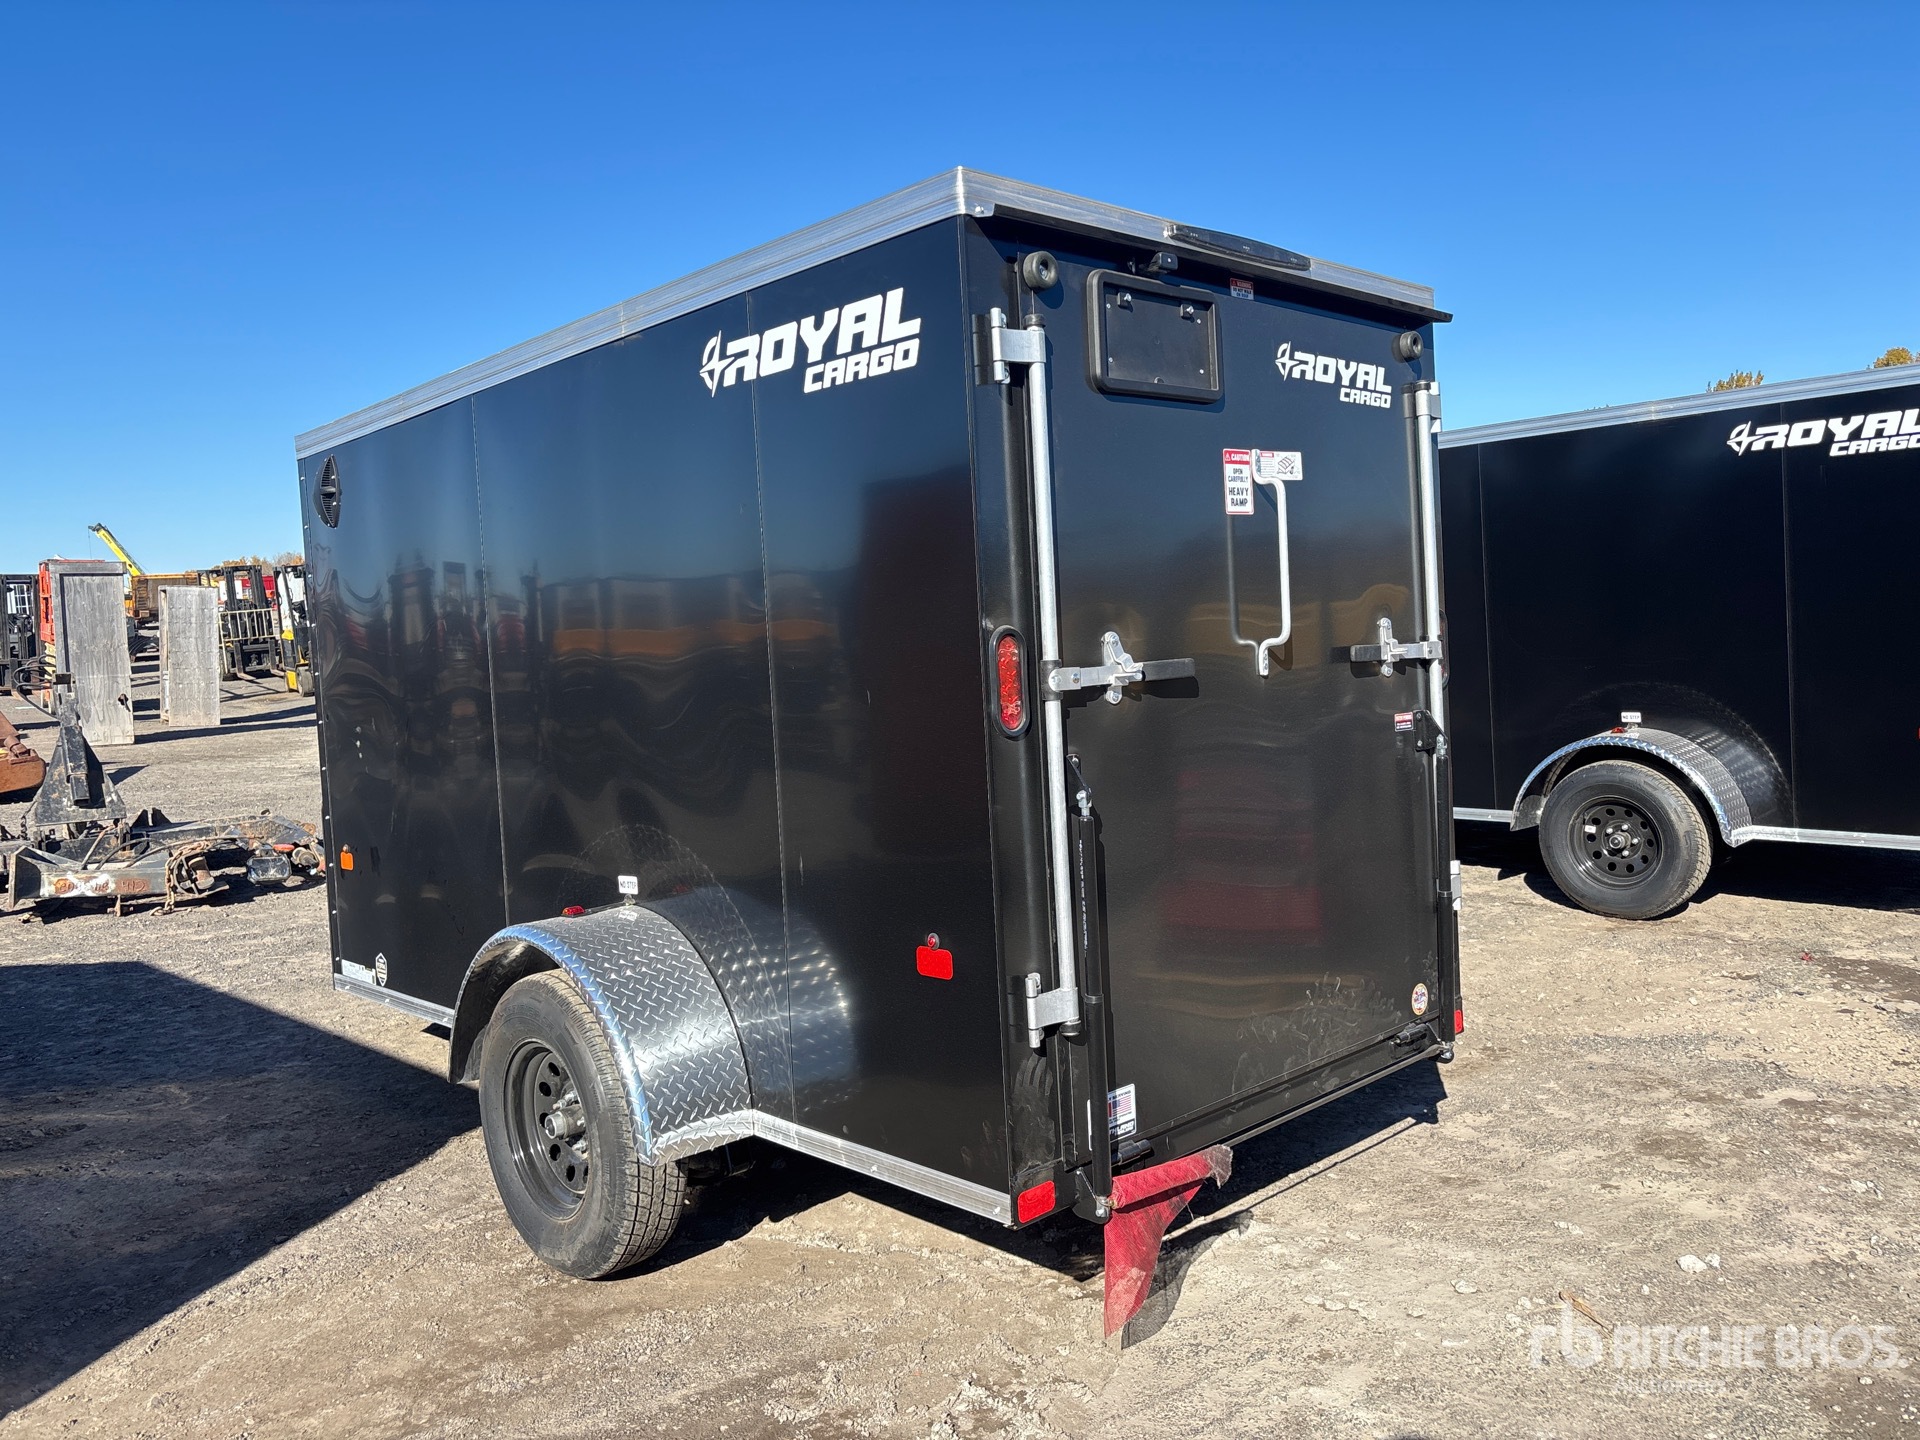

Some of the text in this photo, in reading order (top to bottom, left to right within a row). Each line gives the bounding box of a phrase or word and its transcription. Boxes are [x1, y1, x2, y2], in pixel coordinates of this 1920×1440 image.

[723, 287, 921, 387] ROYAL
[803, 338, 920, 393] CARGO
[1292, 351, 1392, 393] ROYAL
[1340, 387, 1391, 408] CARGO
[1229, 487, 1248, 496] HEAVY
[1231, 498, 1248, 507] RAMP
